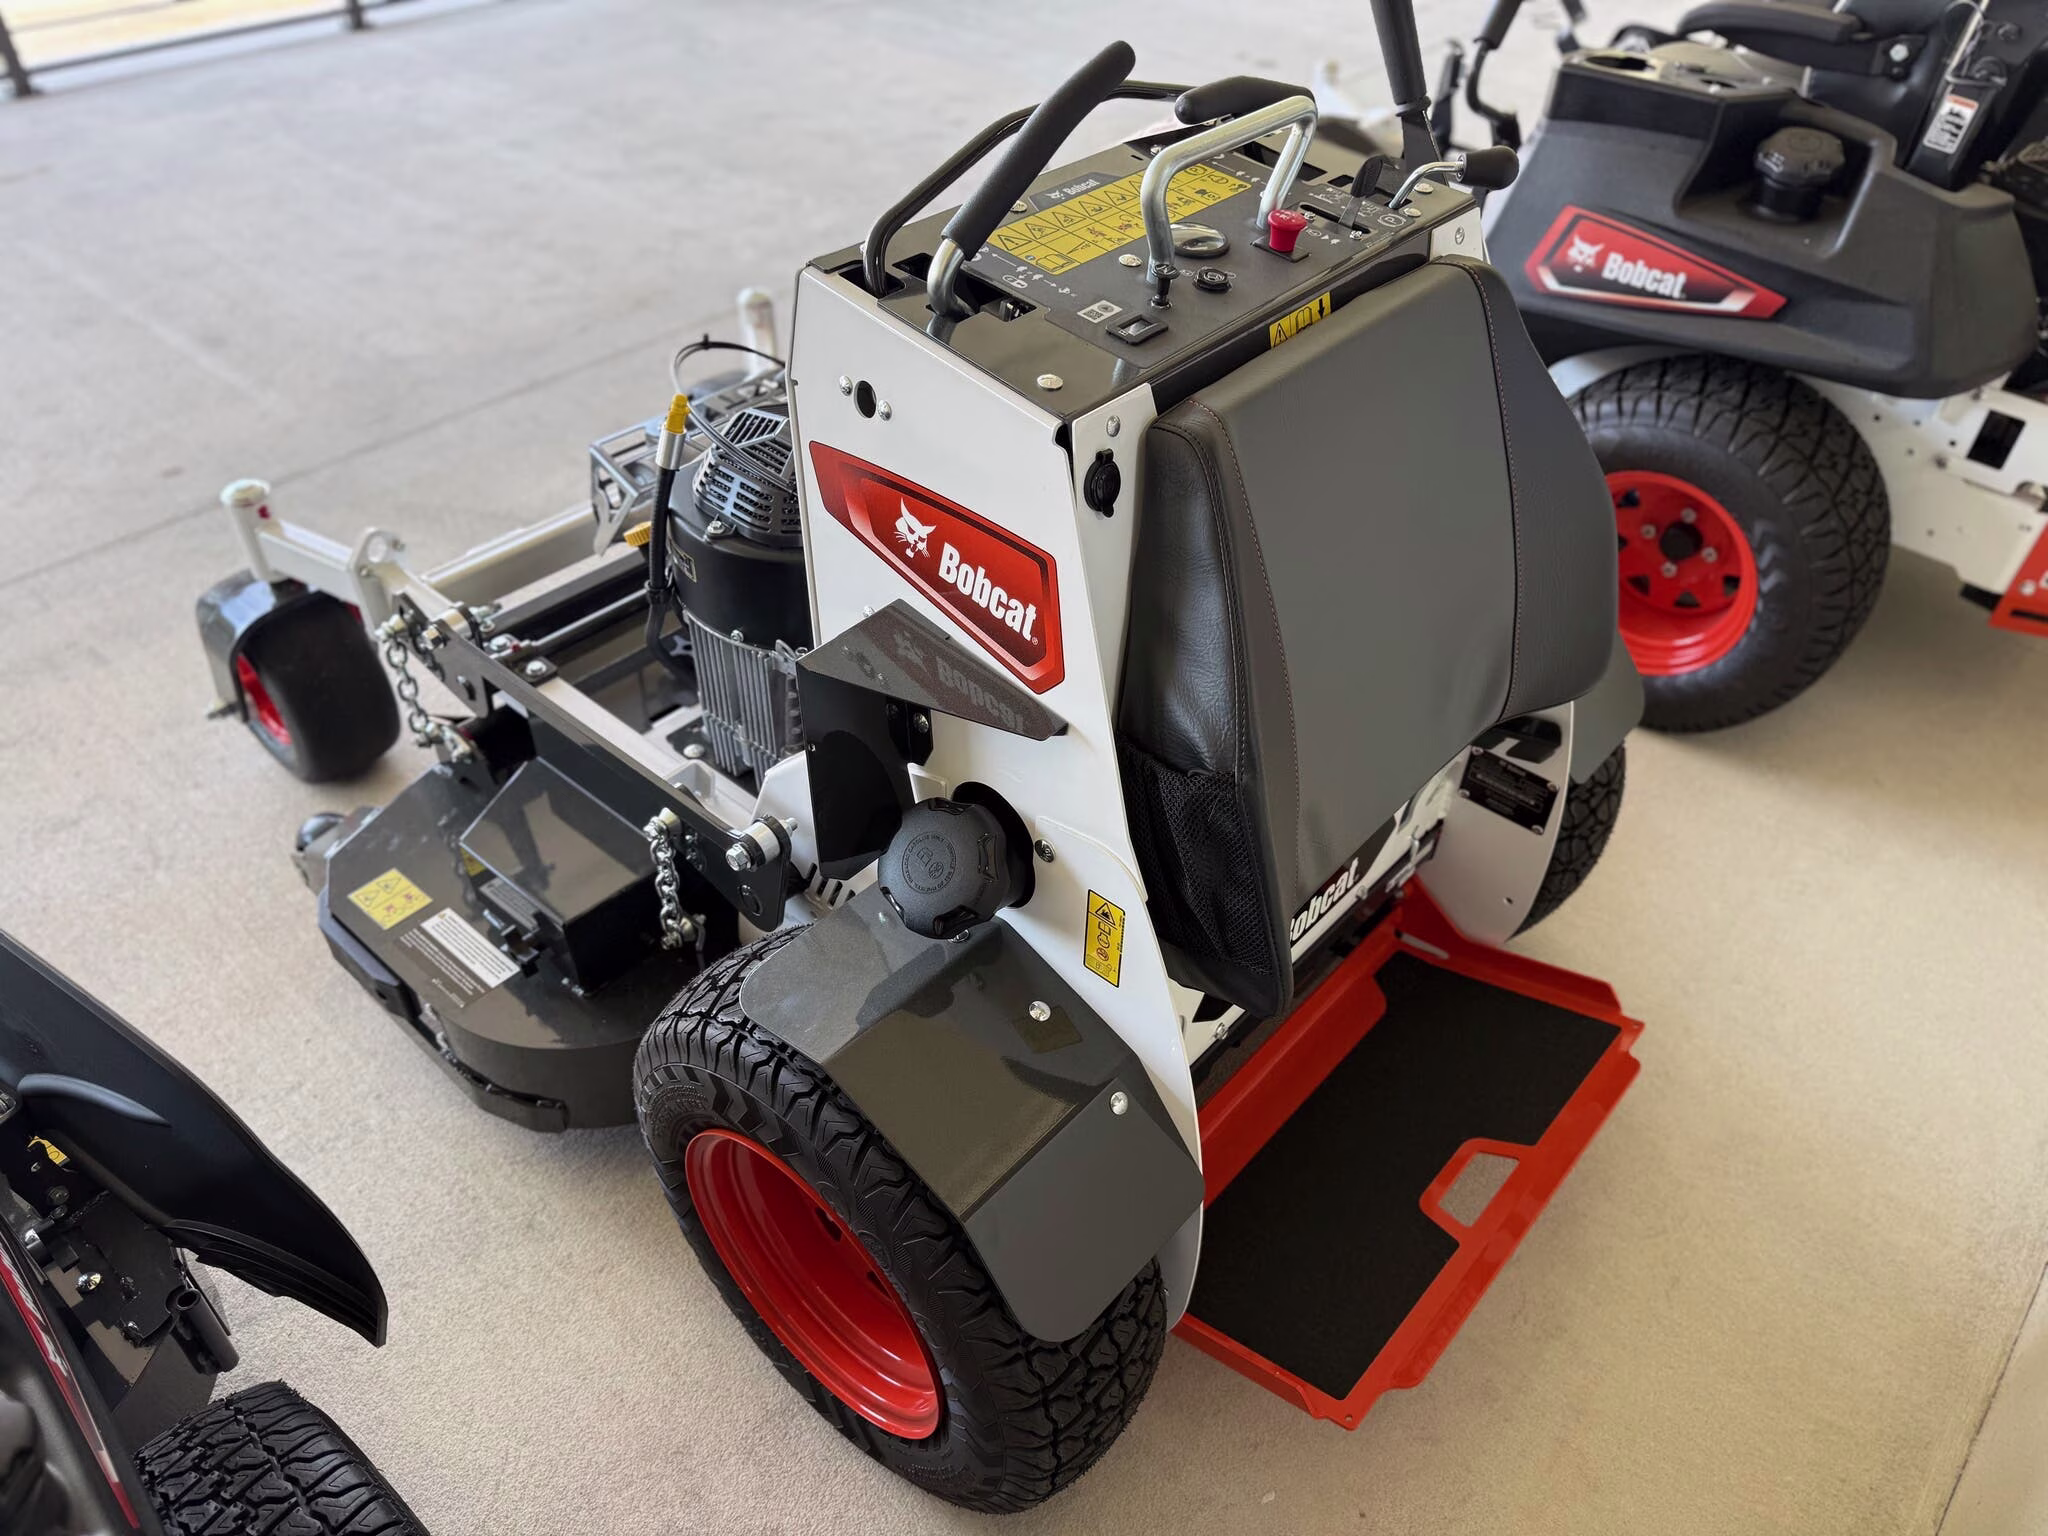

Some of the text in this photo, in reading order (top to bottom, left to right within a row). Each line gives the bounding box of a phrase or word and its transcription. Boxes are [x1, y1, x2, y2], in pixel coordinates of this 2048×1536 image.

[1062, 179, 1101, 195] Bobcat
[1601, 251, 1687, 299] Bobcat
[938, 541, 1037, 642] Bobcat
[1289, 856, 1360, 943] obcat
